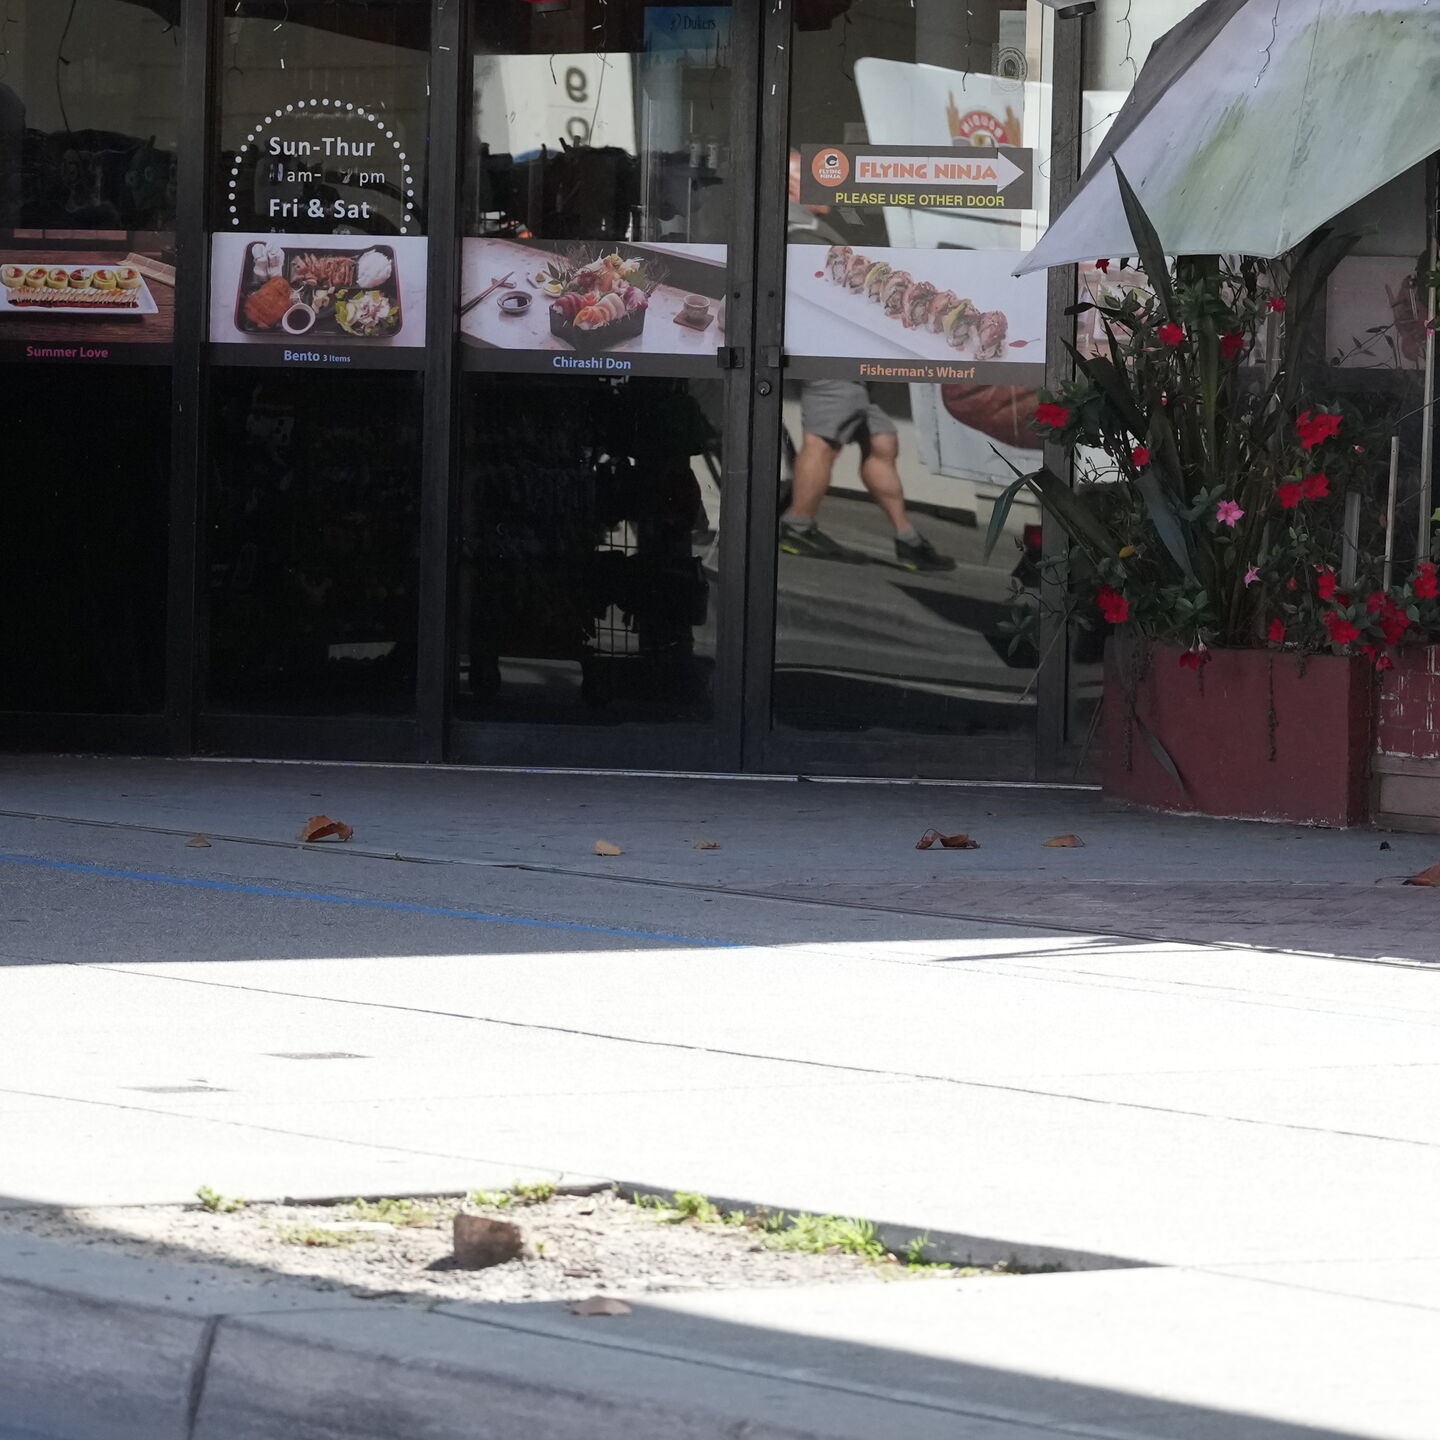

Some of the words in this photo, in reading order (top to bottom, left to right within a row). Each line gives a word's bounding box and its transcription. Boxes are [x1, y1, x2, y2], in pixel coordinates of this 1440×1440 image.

[268, 136, 376, 157] Sun-Thur
[359, 171, 385, 186] pm
[860, 162, 928, 179] FLYING
[934, 164, 998, 180] NINJA
[835, 192, 886, 205] PLEASE
[890, 194, 915, 205] USE
[919, 194, 963, 206] OTHER
[967, 195, 1005, 207] DOOR
[268, 198, 299, 217] Fri
[307, 198, 325, 218] &
[333, 199, 370, 219] Sat
[26, 345, 75, 359] Summer
[78, 346, 109, 359] Love
[283, 349, 320, 362] Bento
[552, 355, 601, 370] Chirashi
[605, 357, 632, 370] Don
[860, 363, 933, 378] Fisherman's
[936, 365, 975, 380] Wharf
